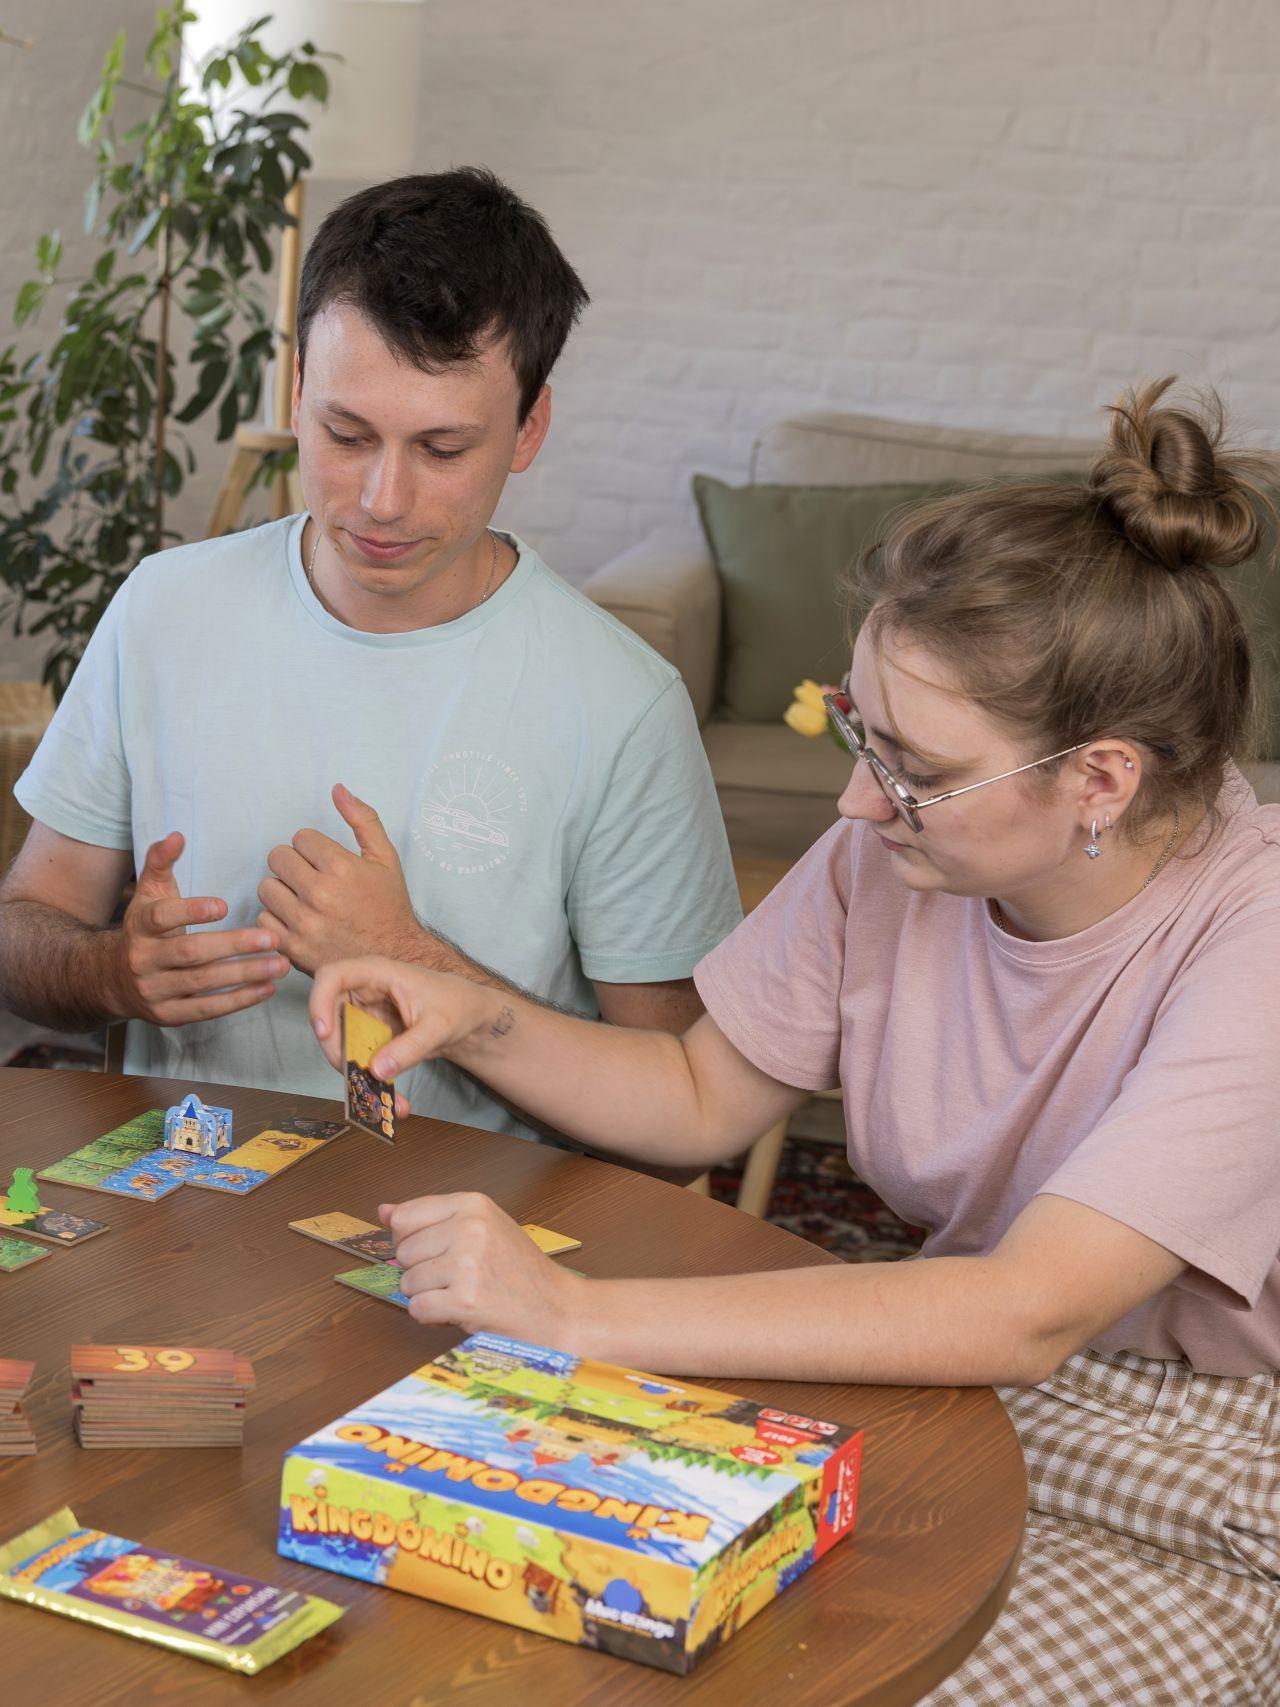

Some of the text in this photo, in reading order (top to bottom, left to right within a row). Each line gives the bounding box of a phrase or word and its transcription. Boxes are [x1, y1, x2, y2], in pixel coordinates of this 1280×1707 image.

[111, 1348, 197, 1374] 39
[335, 1423, 713, 1542] KINGDOMINO
[289, 1484, 515, 1591] KINGDOMINO
